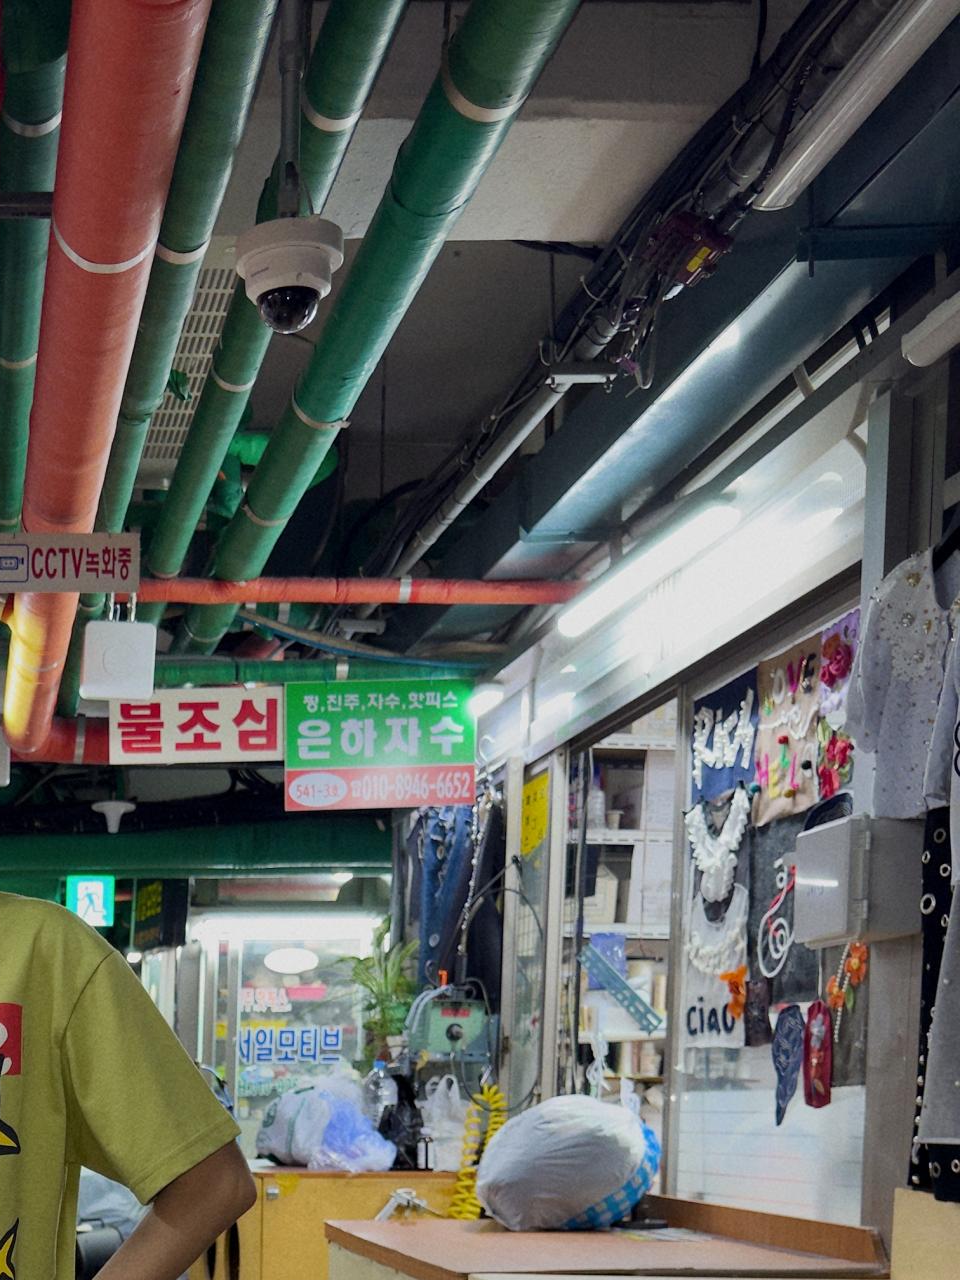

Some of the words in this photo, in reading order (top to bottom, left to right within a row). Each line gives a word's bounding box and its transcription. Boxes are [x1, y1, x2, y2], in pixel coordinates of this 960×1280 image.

[31, 546, 132, 580] CCTV녹화중
[117, 698, 278, 754] 불조심
[297, 715, 464, 760] 은하자수
